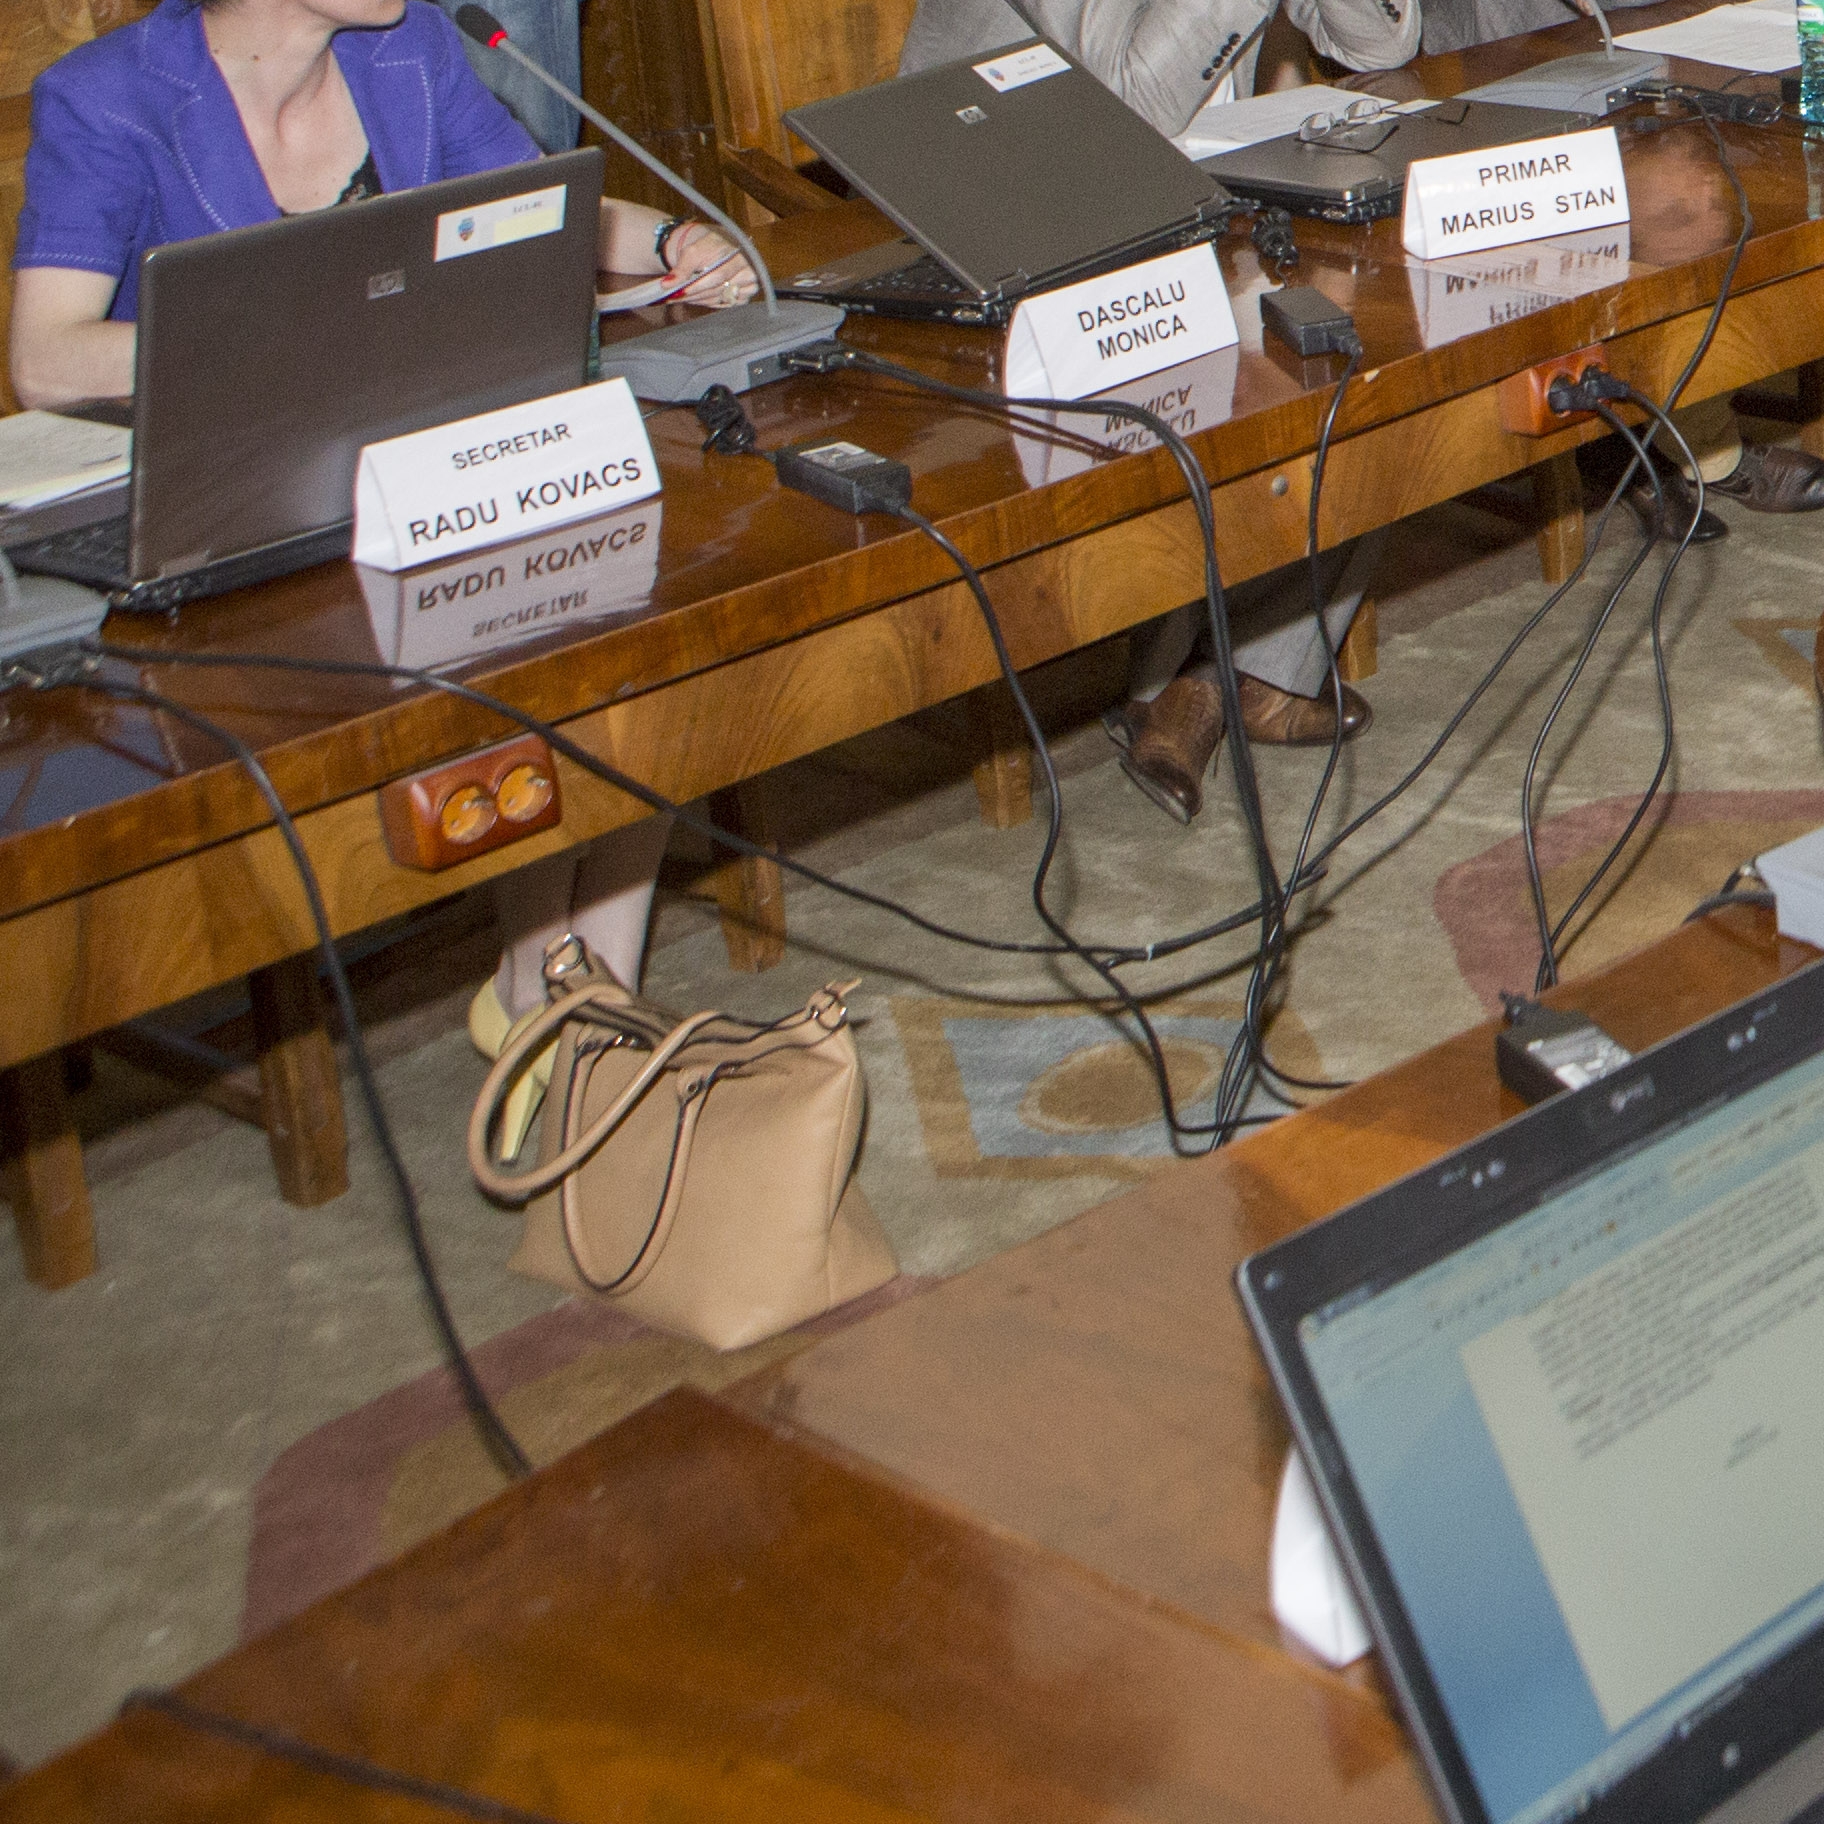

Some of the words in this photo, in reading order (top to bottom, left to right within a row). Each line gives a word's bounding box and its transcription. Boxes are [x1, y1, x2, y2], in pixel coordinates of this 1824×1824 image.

[1478, 153, 1572, 187] PRIMAR
[1441, 201, 1535, 236] MARIUS
[1555, 186, 1616, 214] STAN
[1077, 280, 1187, 332] DASCALU
[1097, 314, 1188, 360] MONICA
[451, 424, 573, 470] SECRETAR
[408, 498, 499, 546] RADU
[516, 457, 643, 514] KOVACS
